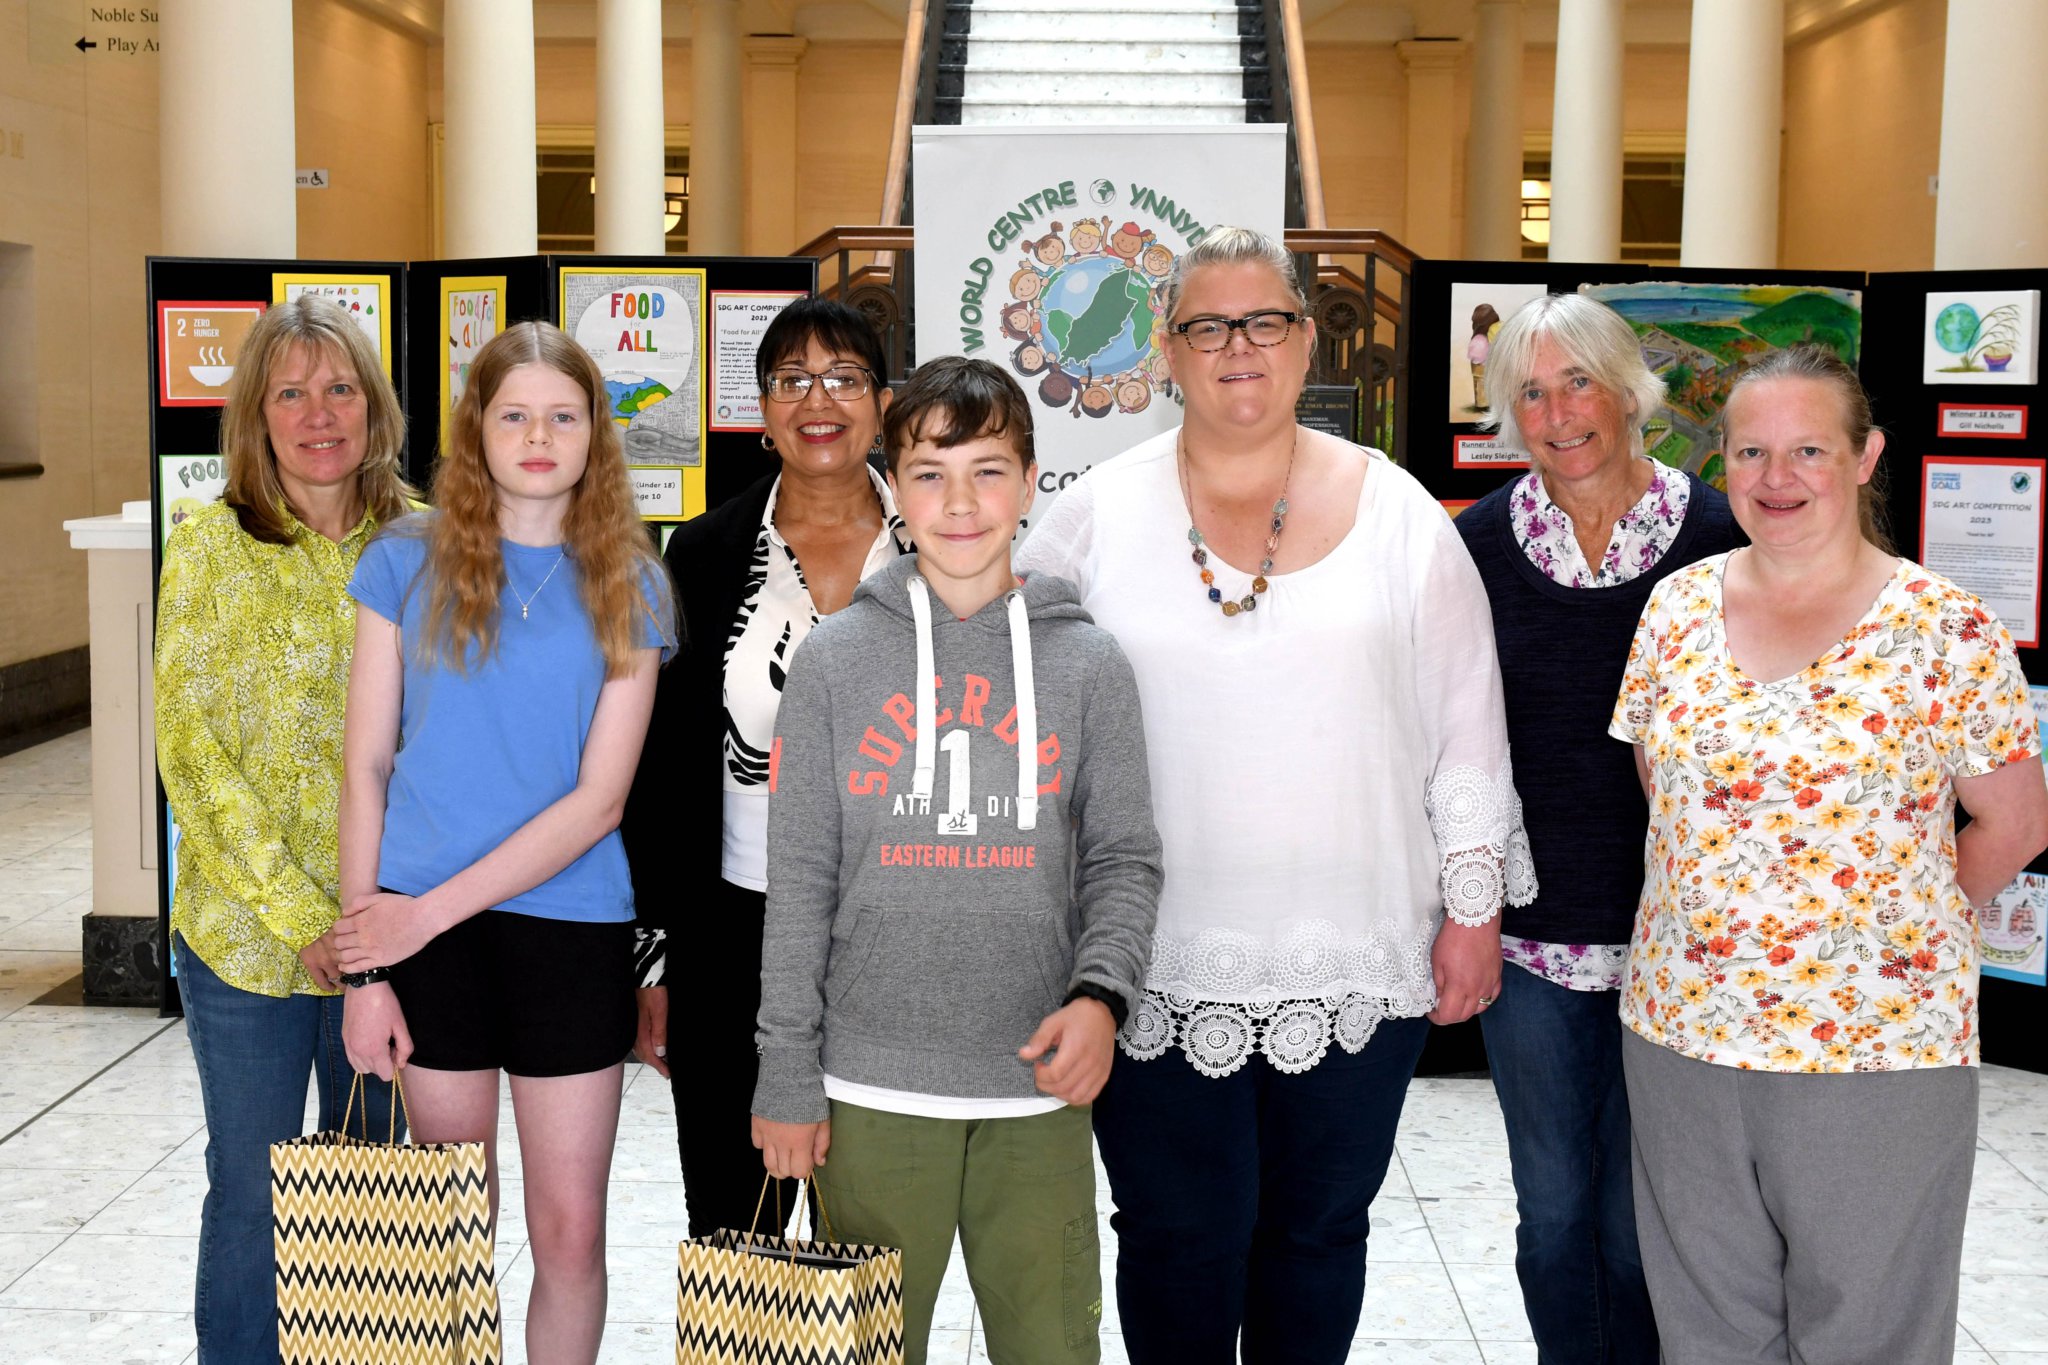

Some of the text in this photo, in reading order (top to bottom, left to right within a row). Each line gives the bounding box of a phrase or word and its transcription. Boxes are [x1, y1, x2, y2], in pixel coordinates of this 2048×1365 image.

[91, 8, 135, 22] Noble
[107, 37, 139, 55] Play
[960, 257, 994, 353] WORLD
[987, 181, 1077, 251] CENTRE
[610, 292, 665, 319] FOOD
[177, 318, 211, 337] 2 ZERO
[193, 328, 220, 337] HUNGER
[617, 330, 658, 352] ALL
[1487, 441, 1496, 449] Up
[1931, 481, 1961, 490] GOALS
[1932, 501, 1950, 509] SDG
[1973, 503, 2032, 511] COMPETITION
[892, 794, 1021, 817] ATH DI
[880, 844, 1036, 869] EASTERN LEAGUE
